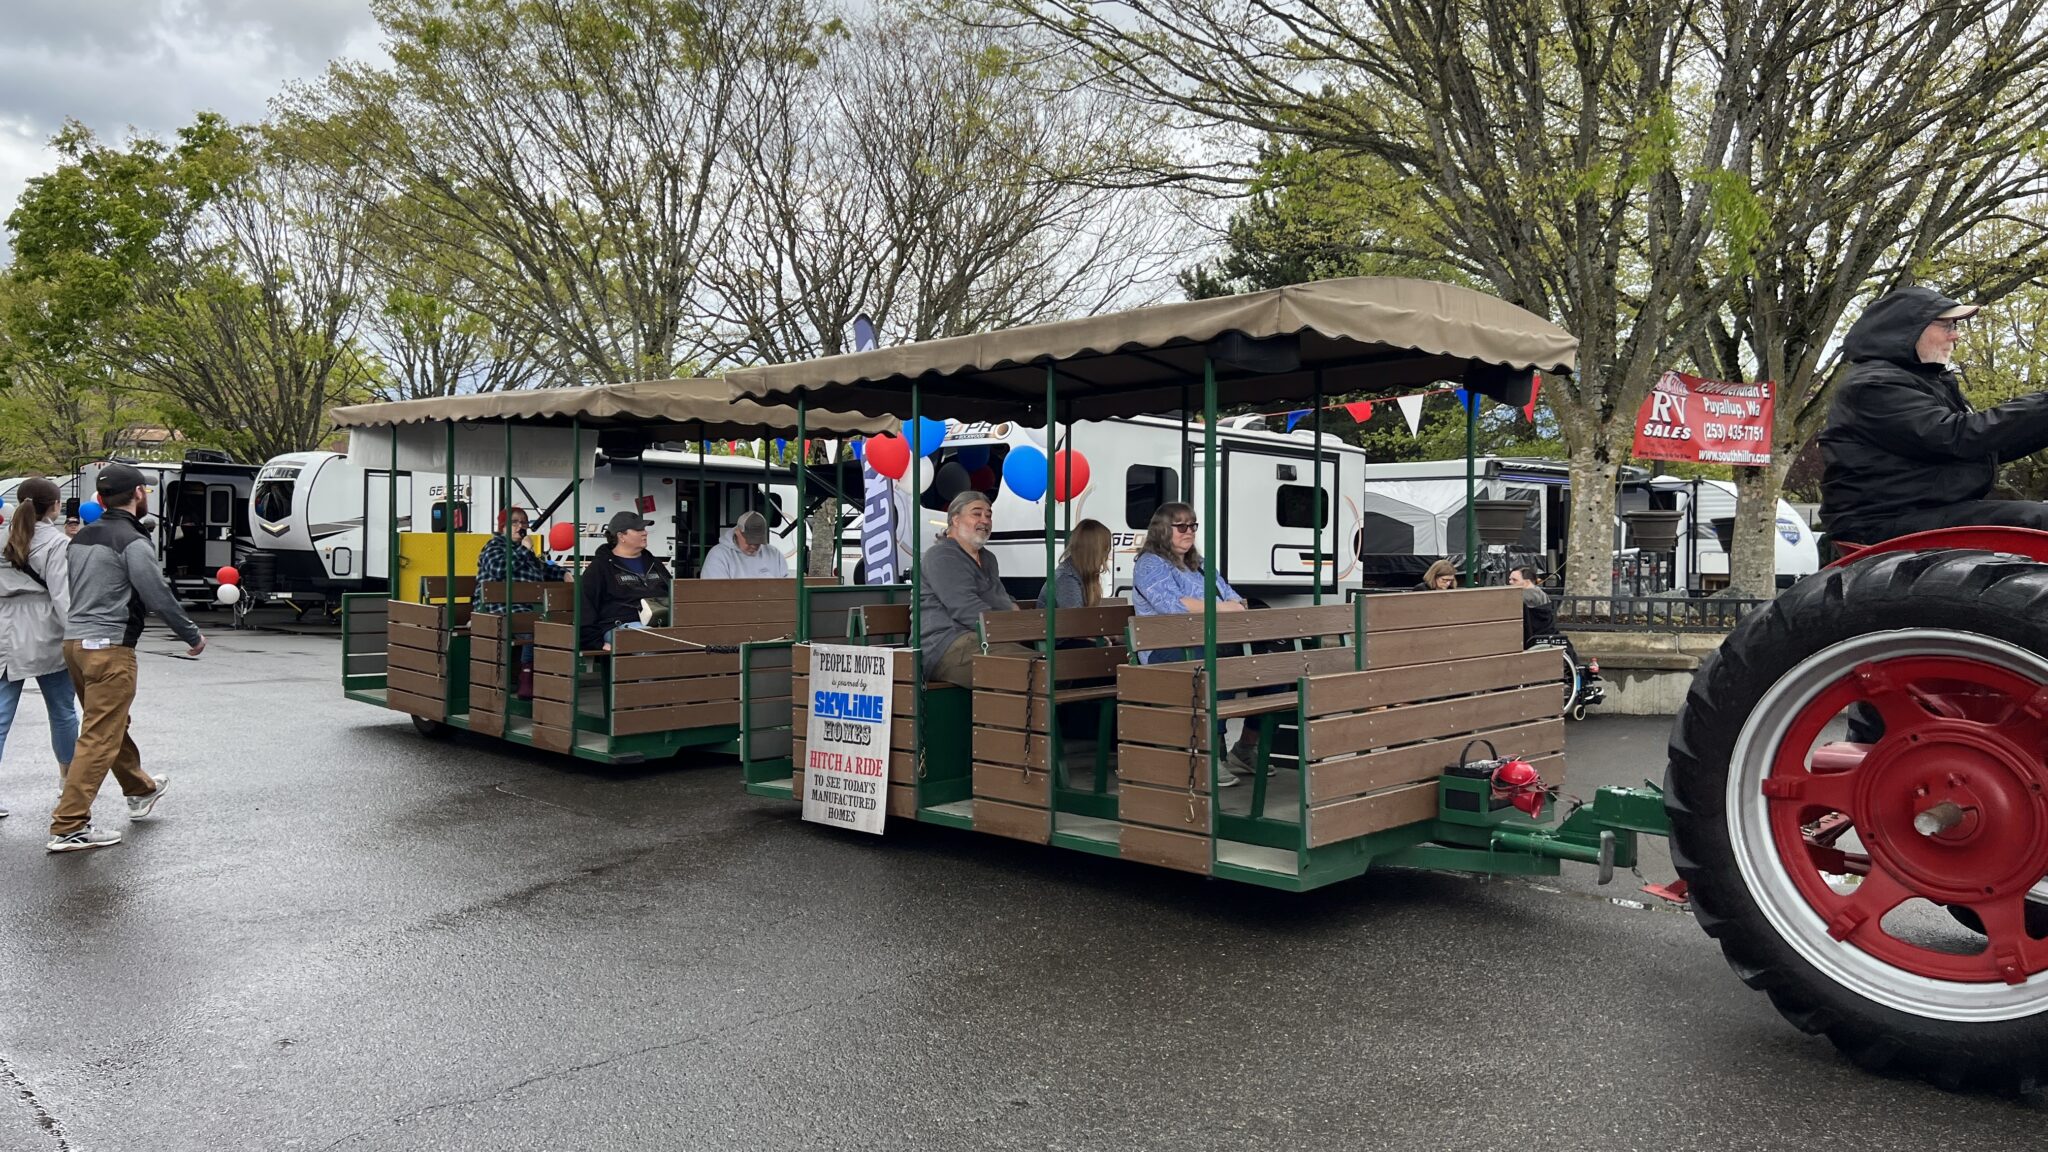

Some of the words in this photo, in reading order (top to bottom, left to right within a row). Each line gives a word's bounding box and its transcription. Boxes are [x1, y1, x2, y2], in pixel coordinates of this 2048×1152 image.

[1649, 390, 1686, 424] RV
[1703, 397, 1745, 418] Puyallup,
[1746, 400, 1760, 416] Wa
[1643, 423, 1691, 440] SALES
[1703, 422, 1726, 442] (253)
[1727, 424, 1764, 440] 435-7751
[1699, 450, 1770, 464] www.southhillrv.com
[820, 653, 852, 673] PEOPLE
[854, 655, 885, 675] MOVER
[860, 679, 867, 691] by
[823, 720, 871, 746] HOMES
[810, 751, 842, 772] HITCH
[844, 756, 853, 773] A
[855, 757, 883, 777] RIDE
[814, 774, 824, 786] TO
[826, 776, 840, 789] SEE
[843, 778, 876, 794] TODAY'S
[811, 789, 876, 811] MANUFACTURED
[828, 807, 856, 822] HOMES
